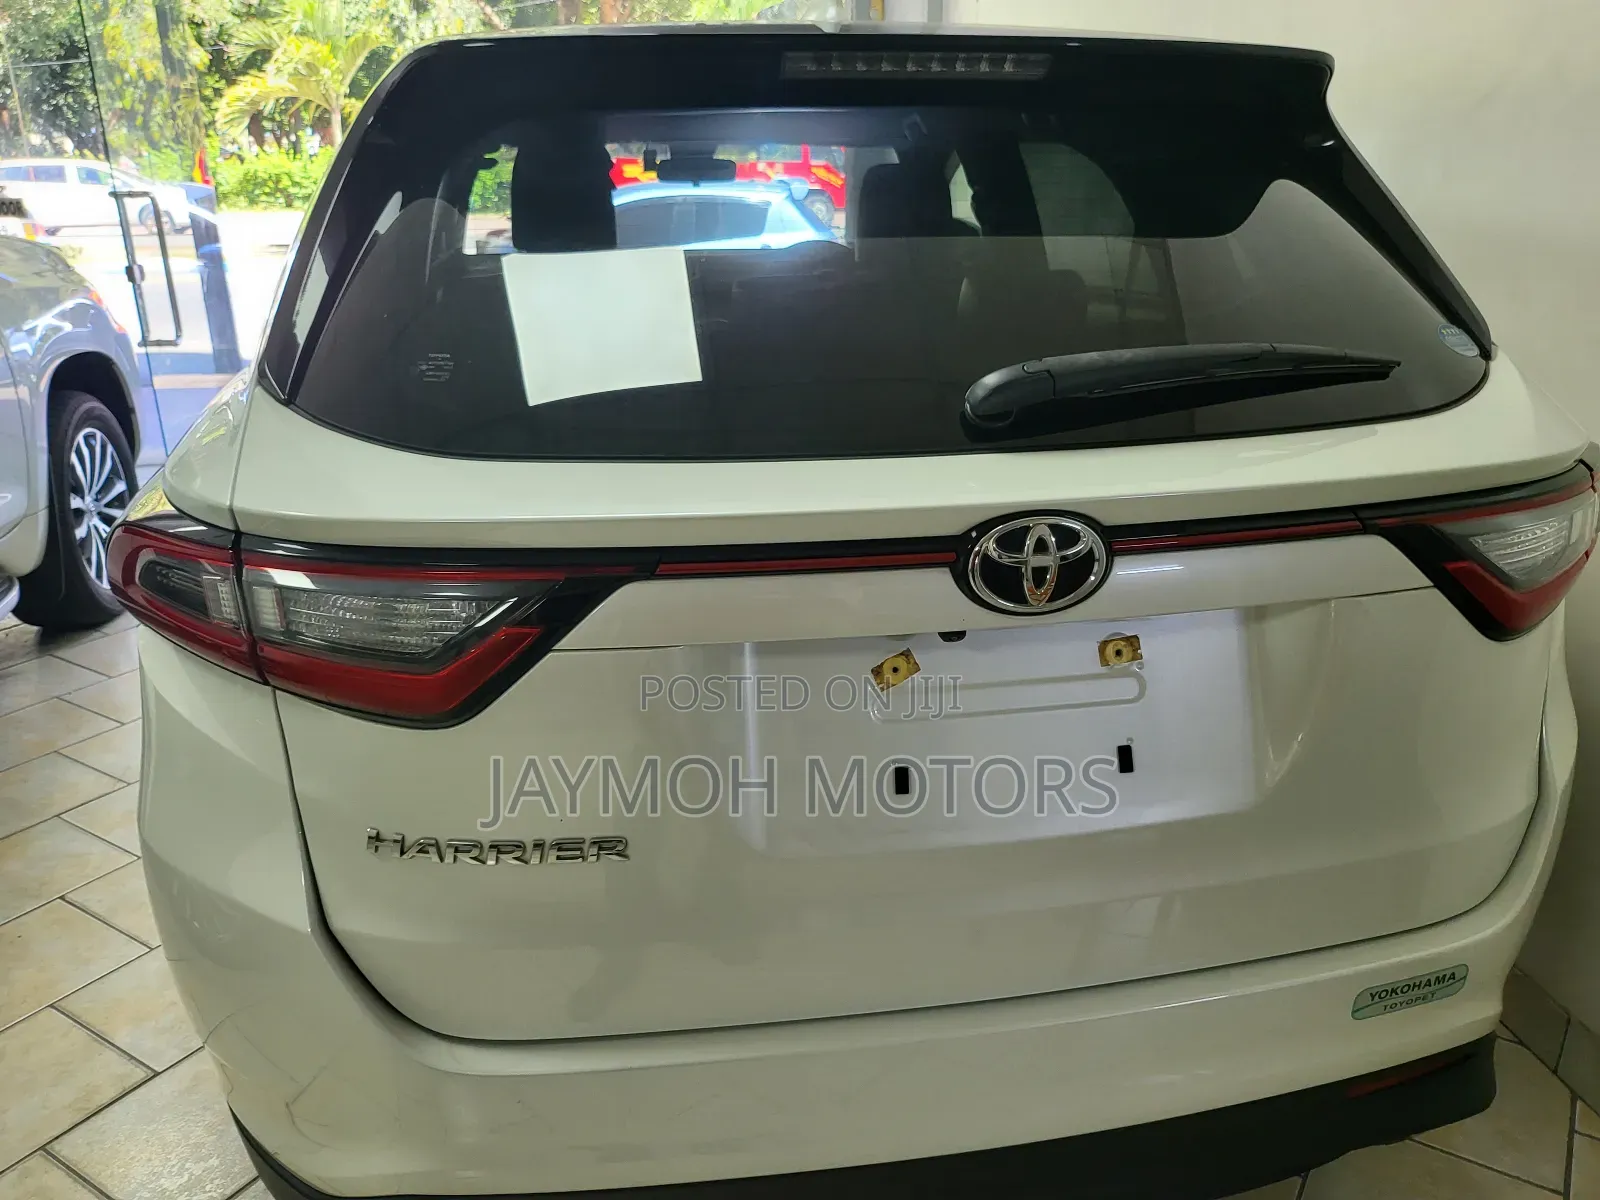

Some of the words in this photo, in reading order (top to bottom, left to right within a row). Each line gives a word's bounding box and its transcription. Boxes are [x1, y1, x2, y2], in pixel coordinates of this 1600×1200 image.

[366, 827, 630, 866] HARRIER
[1369, 971, 1456, 1001] YOKOHAMA
[1383, 992, 1437, 1011] TOYOPET
